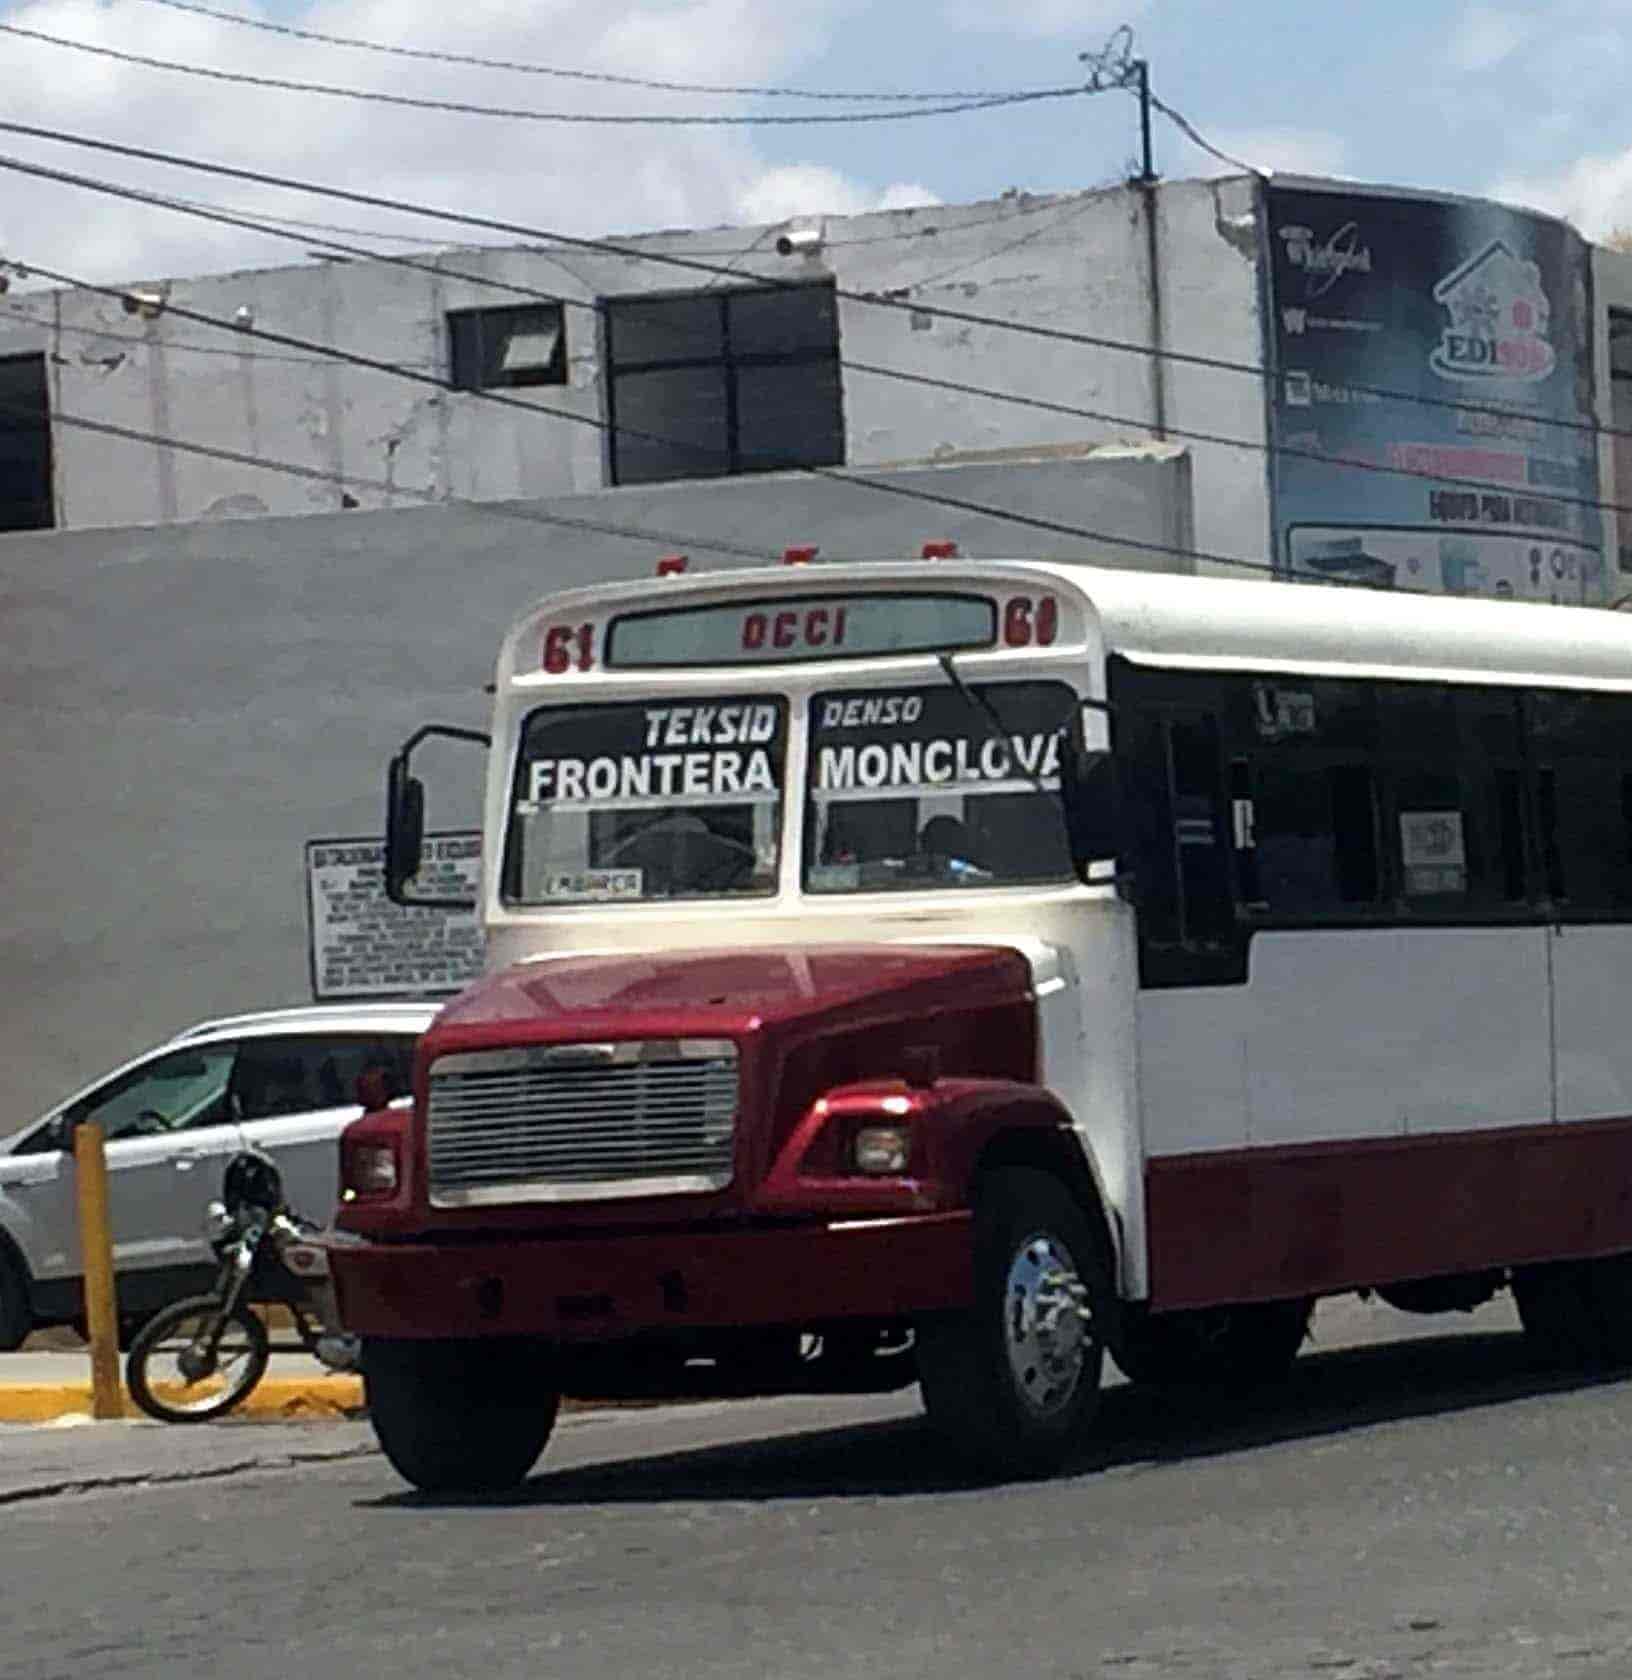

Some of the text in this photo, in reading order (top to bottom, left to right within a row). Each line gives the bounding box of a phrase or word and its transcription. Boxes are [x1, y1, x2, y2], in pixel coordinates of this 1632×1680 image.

[543, 623, 595, 674] 61
[742, 607, 846, 649] OCCI
[646, 705, 776, 747] TEKSID
[821, 696, 923, 727] DENSO
[530, 750, 775, 802] FRONTERA
